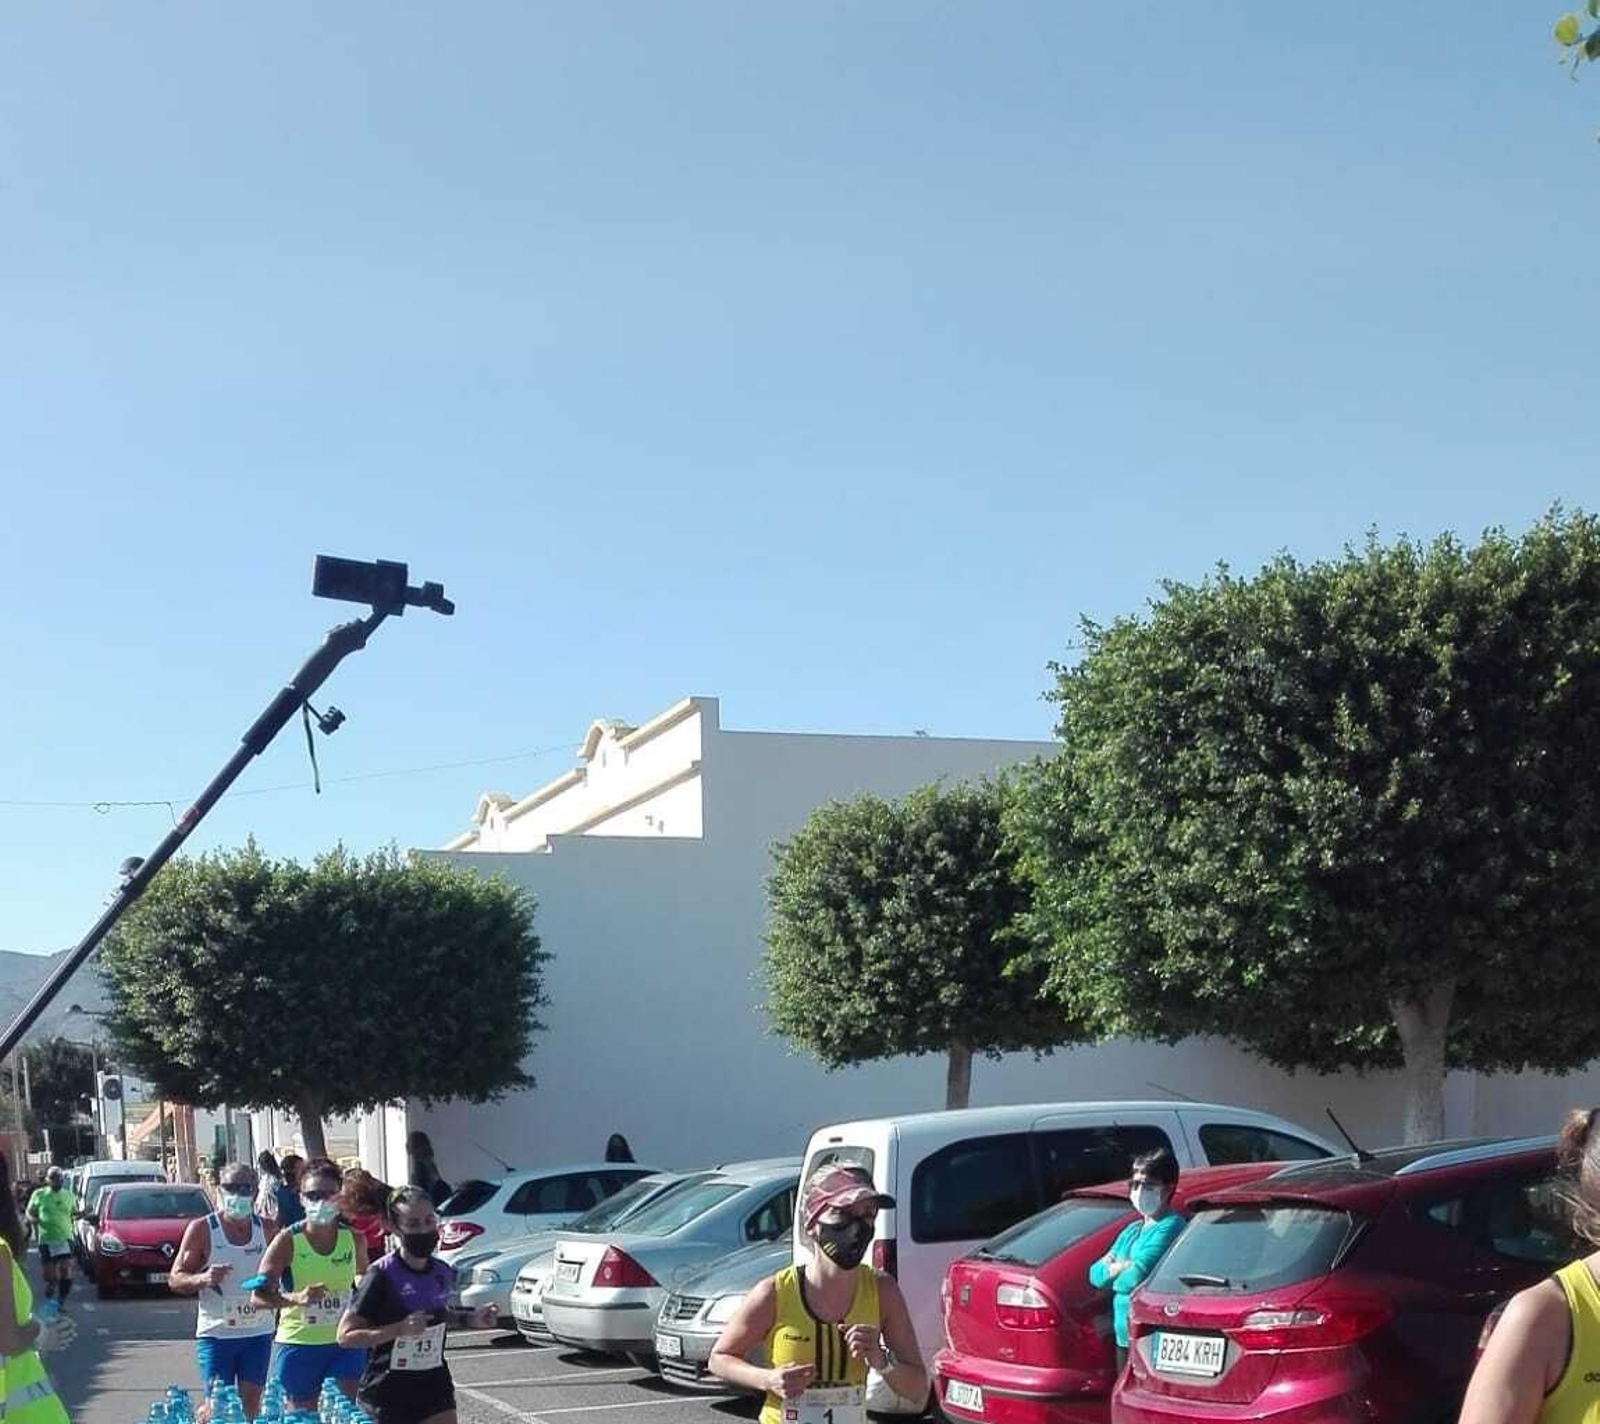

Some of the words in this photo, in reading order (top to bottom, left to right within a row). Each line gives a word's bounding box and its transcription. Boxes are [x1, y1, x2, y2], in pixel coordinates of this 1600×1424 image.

[414, 1340, 432, 1352] 13
[1161, 1338, 1190, 1361] 8284
[1194, 1341, 1221, 1366] KRH
